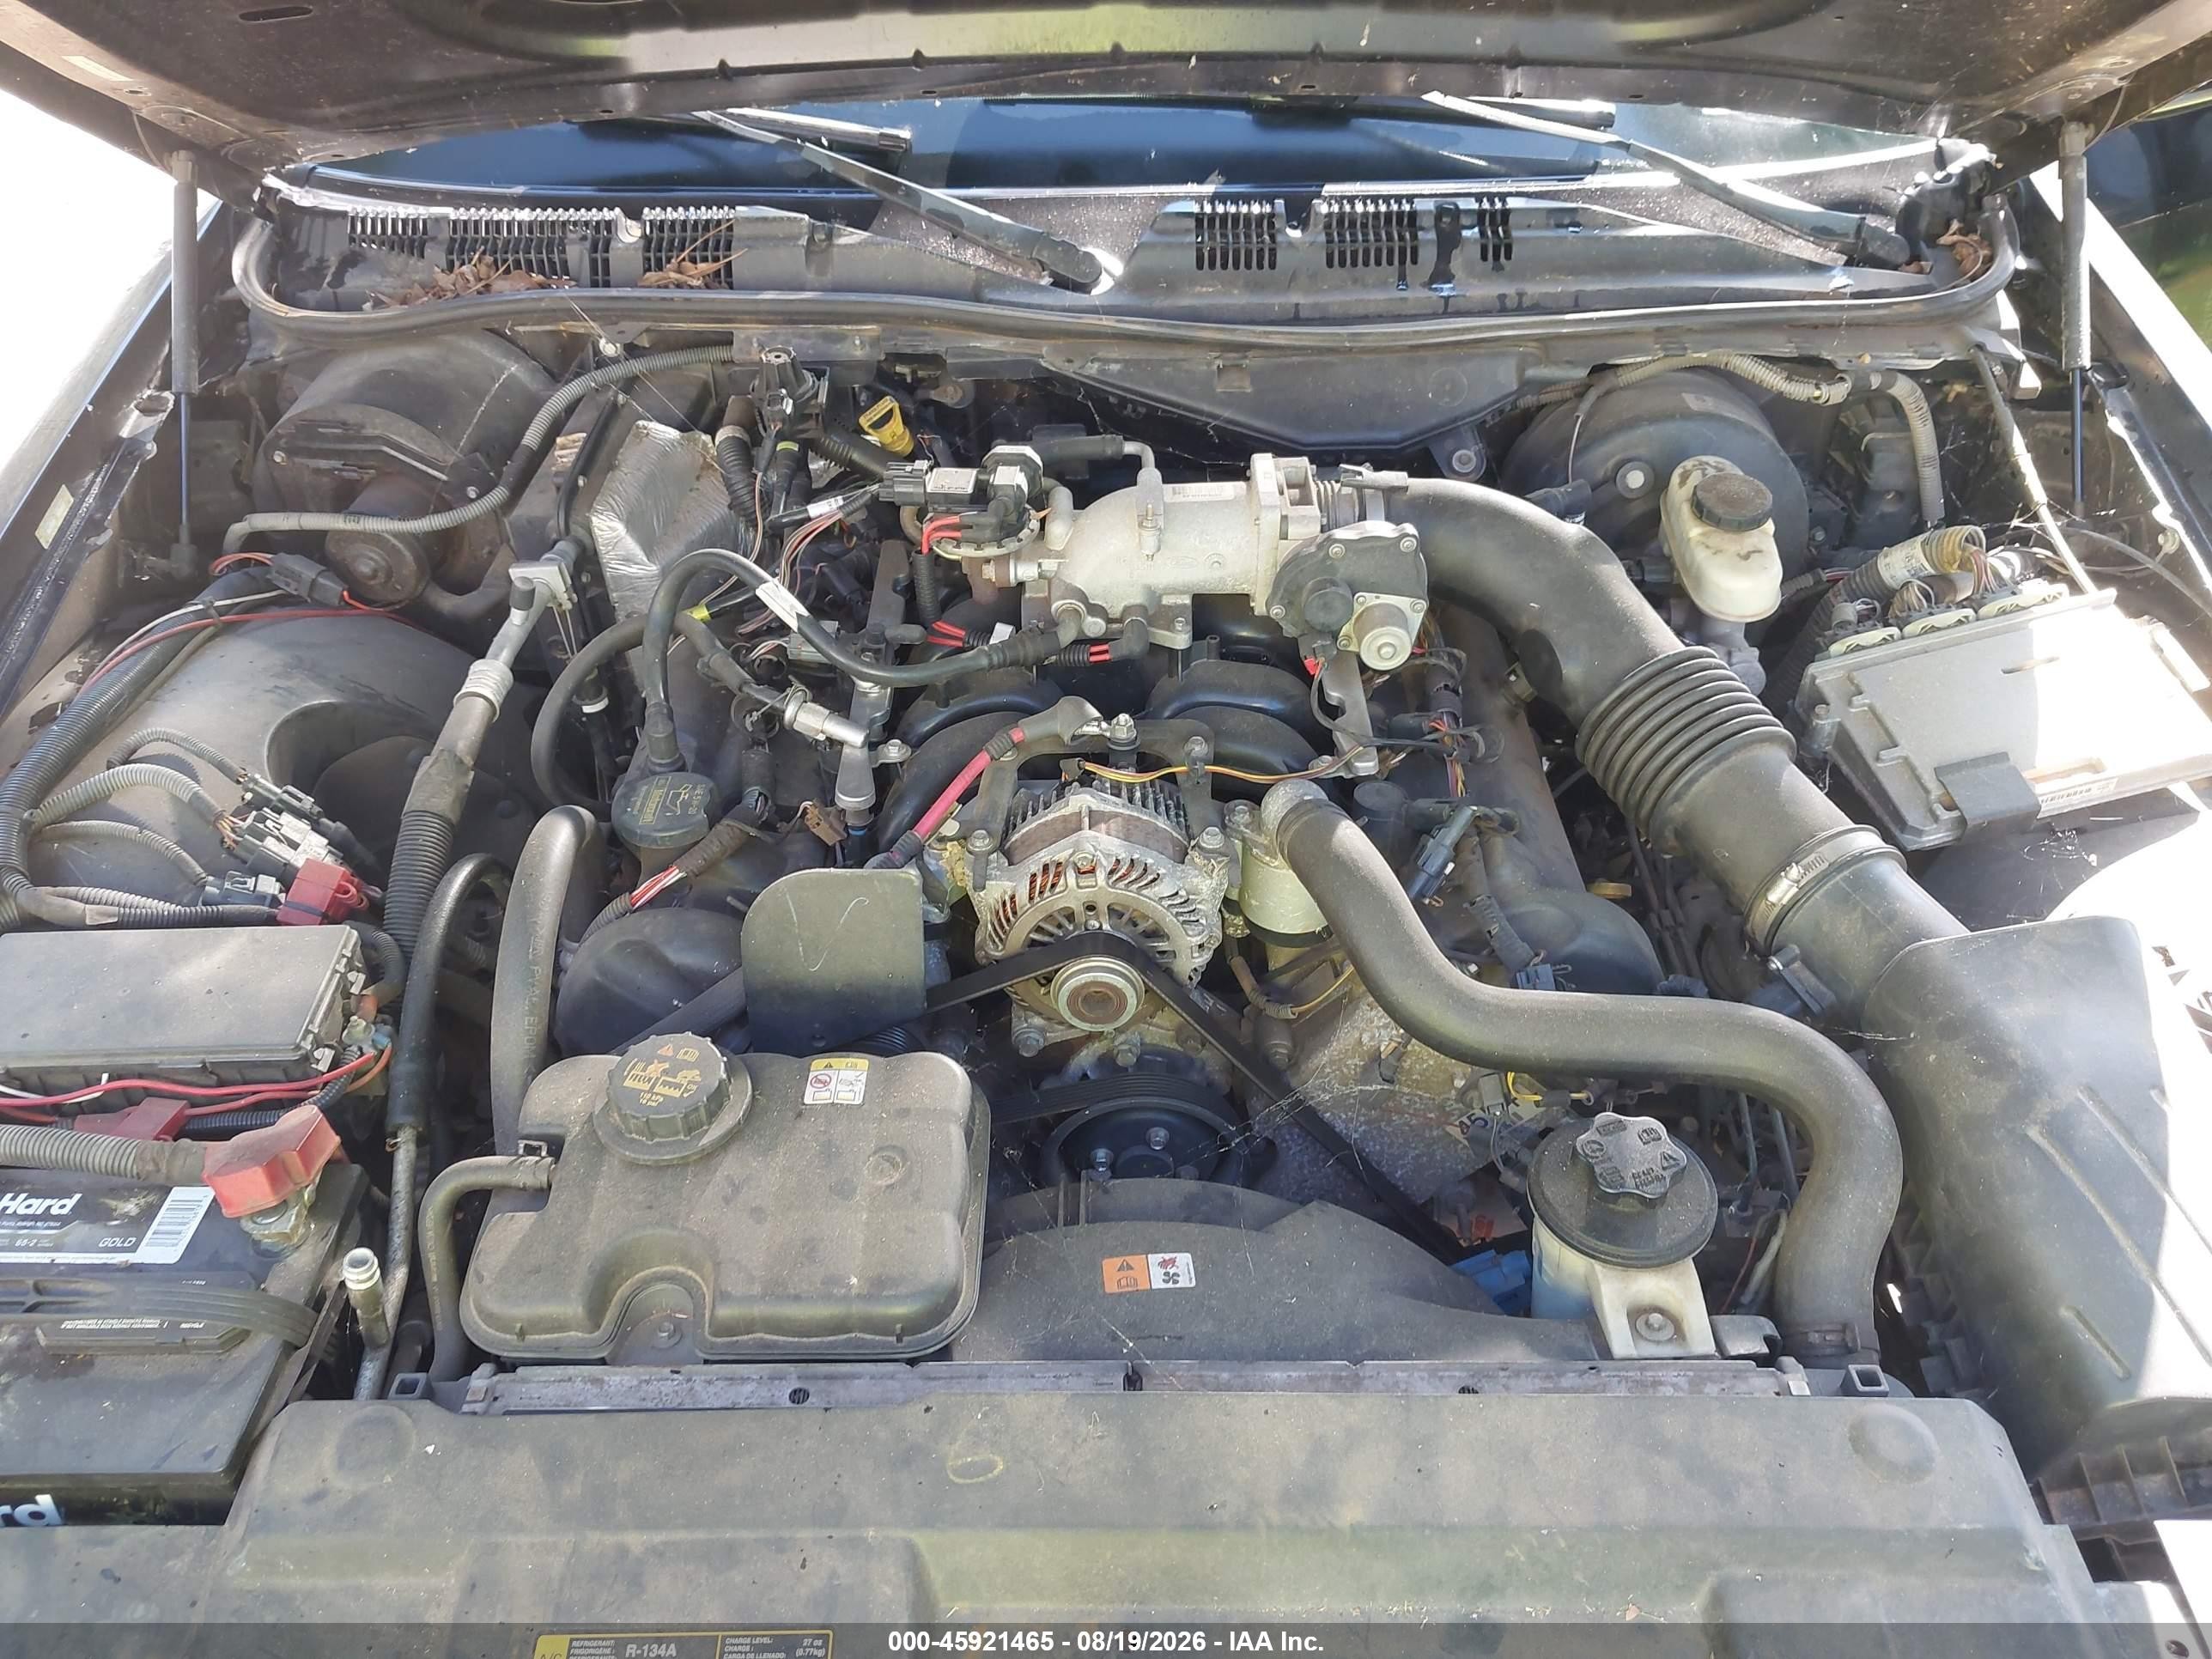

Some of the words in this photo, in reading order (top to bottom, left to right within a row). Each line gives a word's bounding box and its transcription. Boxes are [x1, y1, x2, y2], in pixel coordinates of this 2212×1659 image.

[0, 1193, 82, 1215] Hard
[98, 1237, 137, 1248] GOLD
[802, 1638, 812, 1647] 27
[625, 1644, 677, 1657] R-134A
[796, 1647, 826, 1658] (0.77kg)
